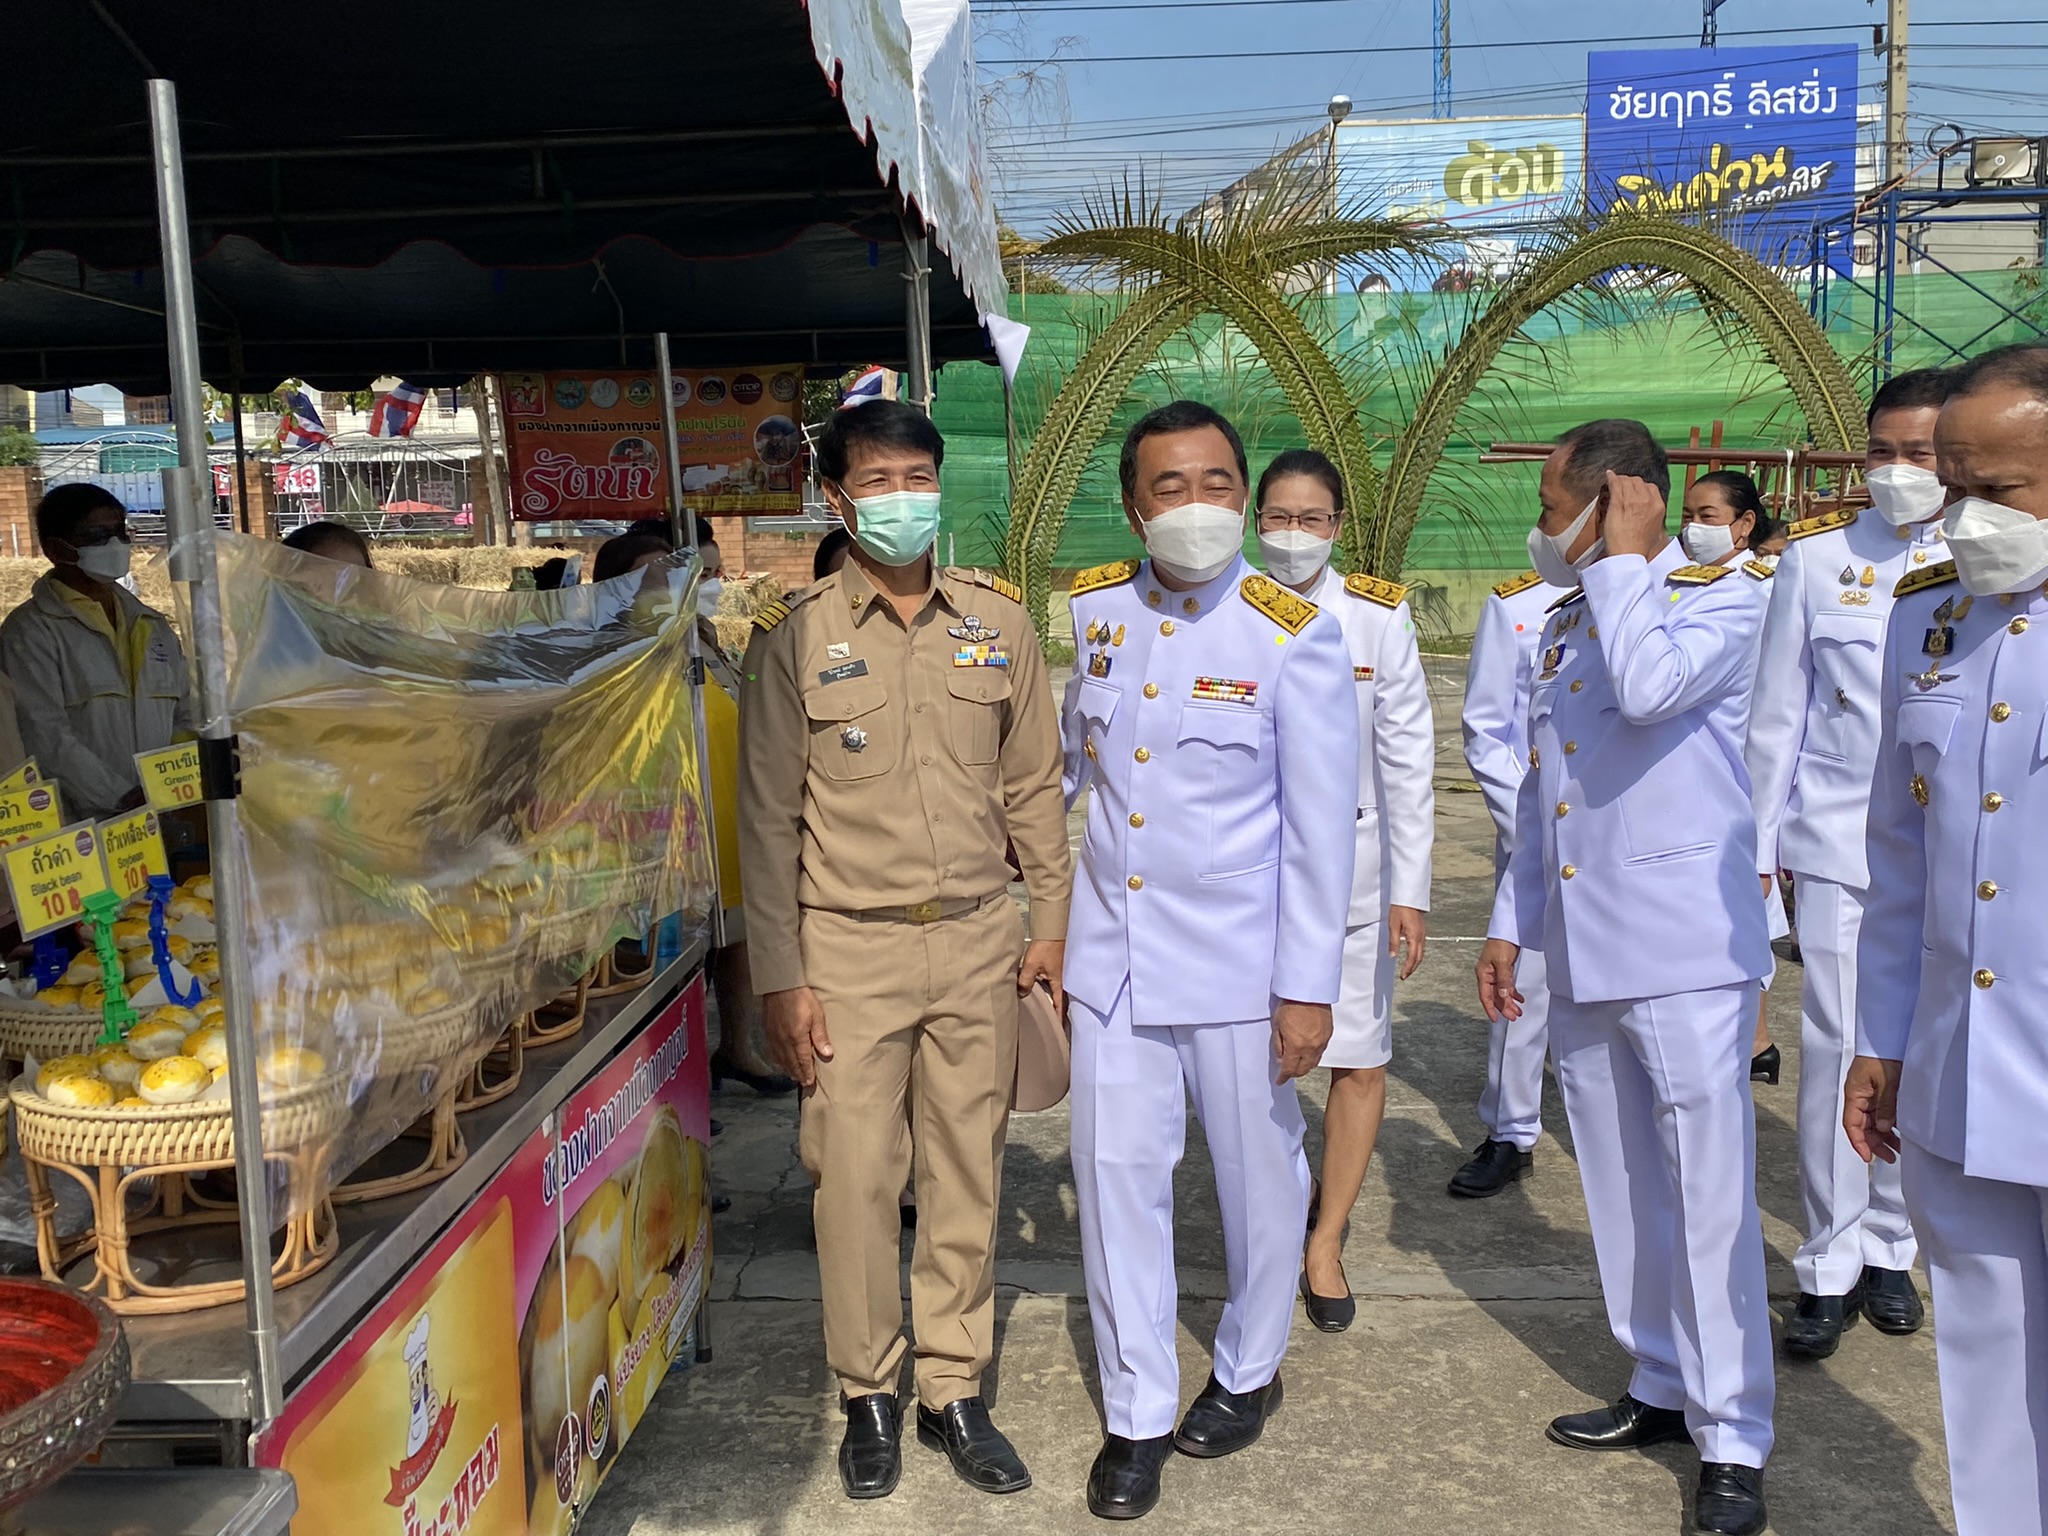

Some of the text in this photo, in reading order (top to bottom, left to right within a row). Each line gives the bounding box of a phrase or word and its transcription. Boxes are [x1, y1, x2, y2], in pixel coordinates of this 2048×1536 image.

[1609, 68, 1838, 129] ชัยฤทธิ์ ลีสซิ่ง
[1447, 140, 1564, 208] ด่วน
[518, 417, 661, 434] ของฝากจากเมืองกาญจน์
[676, 414, 747, 433] คปหมูไร้มัน
[521, 448, 655, 515] รัตนา
[163, 772, 195, 787] Green
[171, 783, 195, 802] 10
[31, 844, 73, 875] ถั่วดำ
[117, 850, 145, 871] Soybean
[30, 869, 83, 897] Black bean
[123, 867, 139, 892] 10
[41, 893, 65, 920] 10
